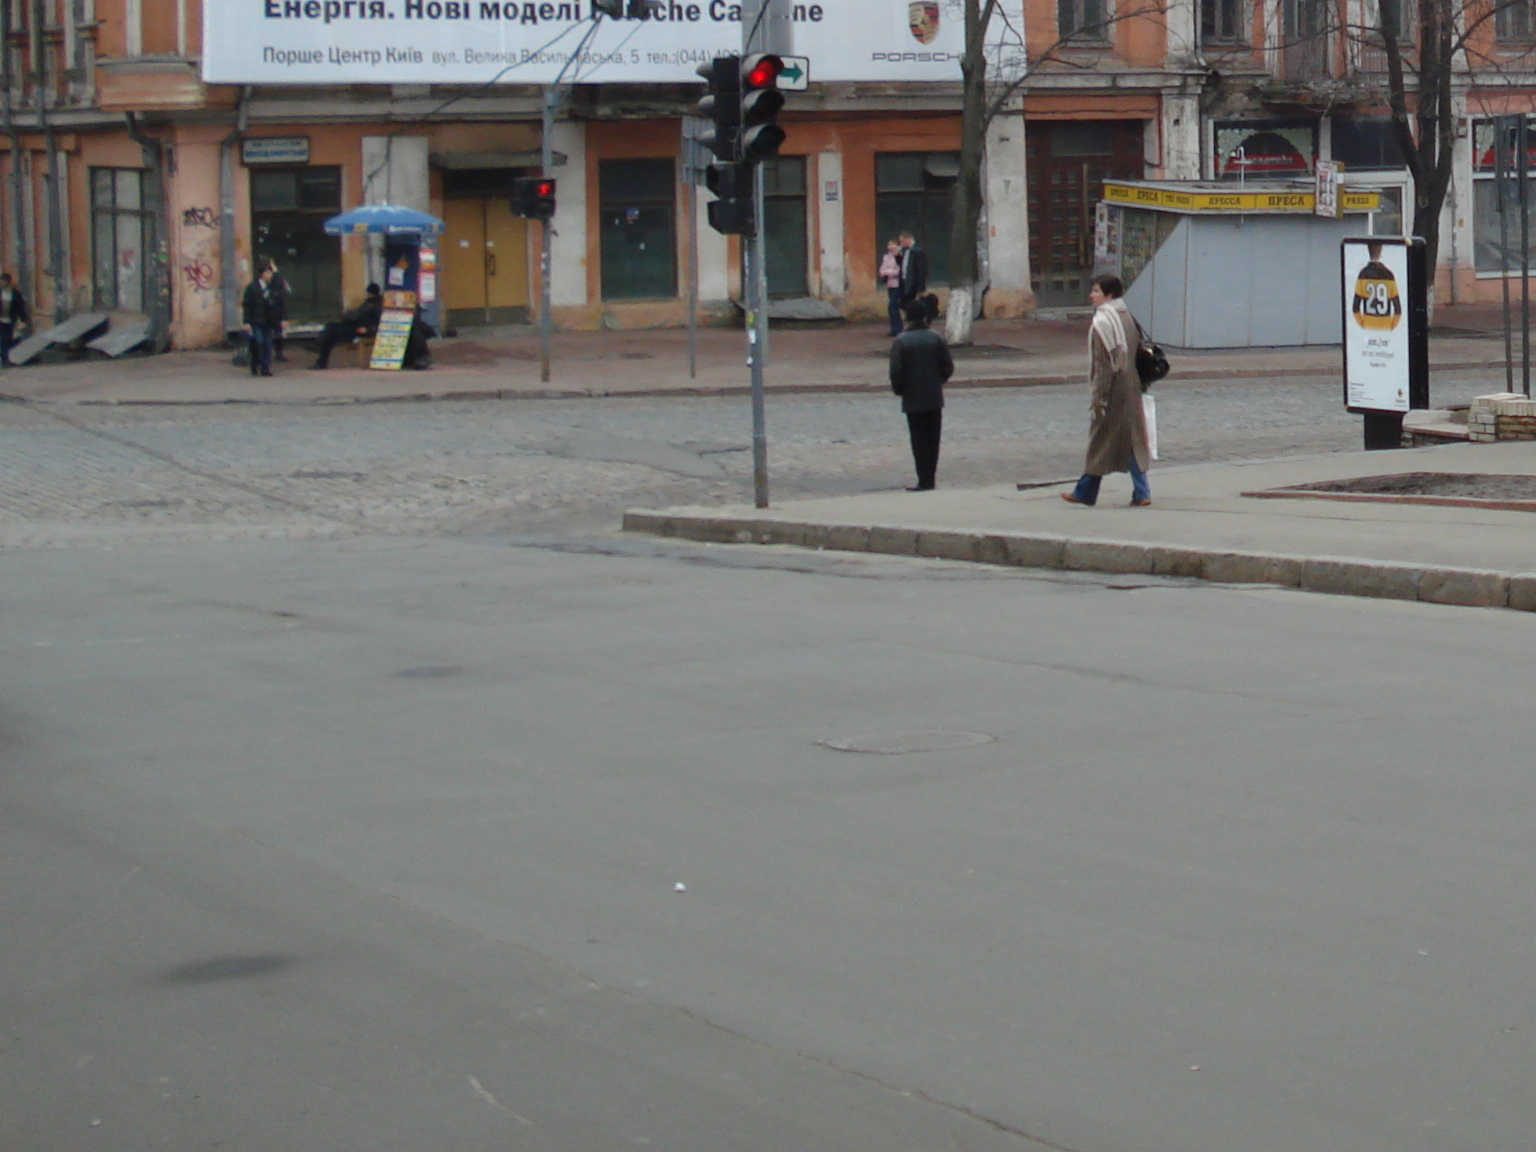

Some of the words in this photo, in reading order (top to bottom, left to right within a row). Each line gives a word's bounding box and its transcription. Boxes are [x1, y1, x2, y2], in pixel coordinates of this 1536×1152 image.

[263, 47, 322, 66] Порше
[328, 47, 381, 67] Центр
[386, 47, 423, 64] Київ
[432, 51, 459, 66] вул.
[465, 49, 516, 64] Велика
[630, 49, 640, 64] 5
[871, 52, 966, 62] PORSCH
[1208, 197, 1241, 205] ПРЕССА
[1268, 196, 1305, 206] ПРЕСА
[1366, 283, 1388, 314] 29
